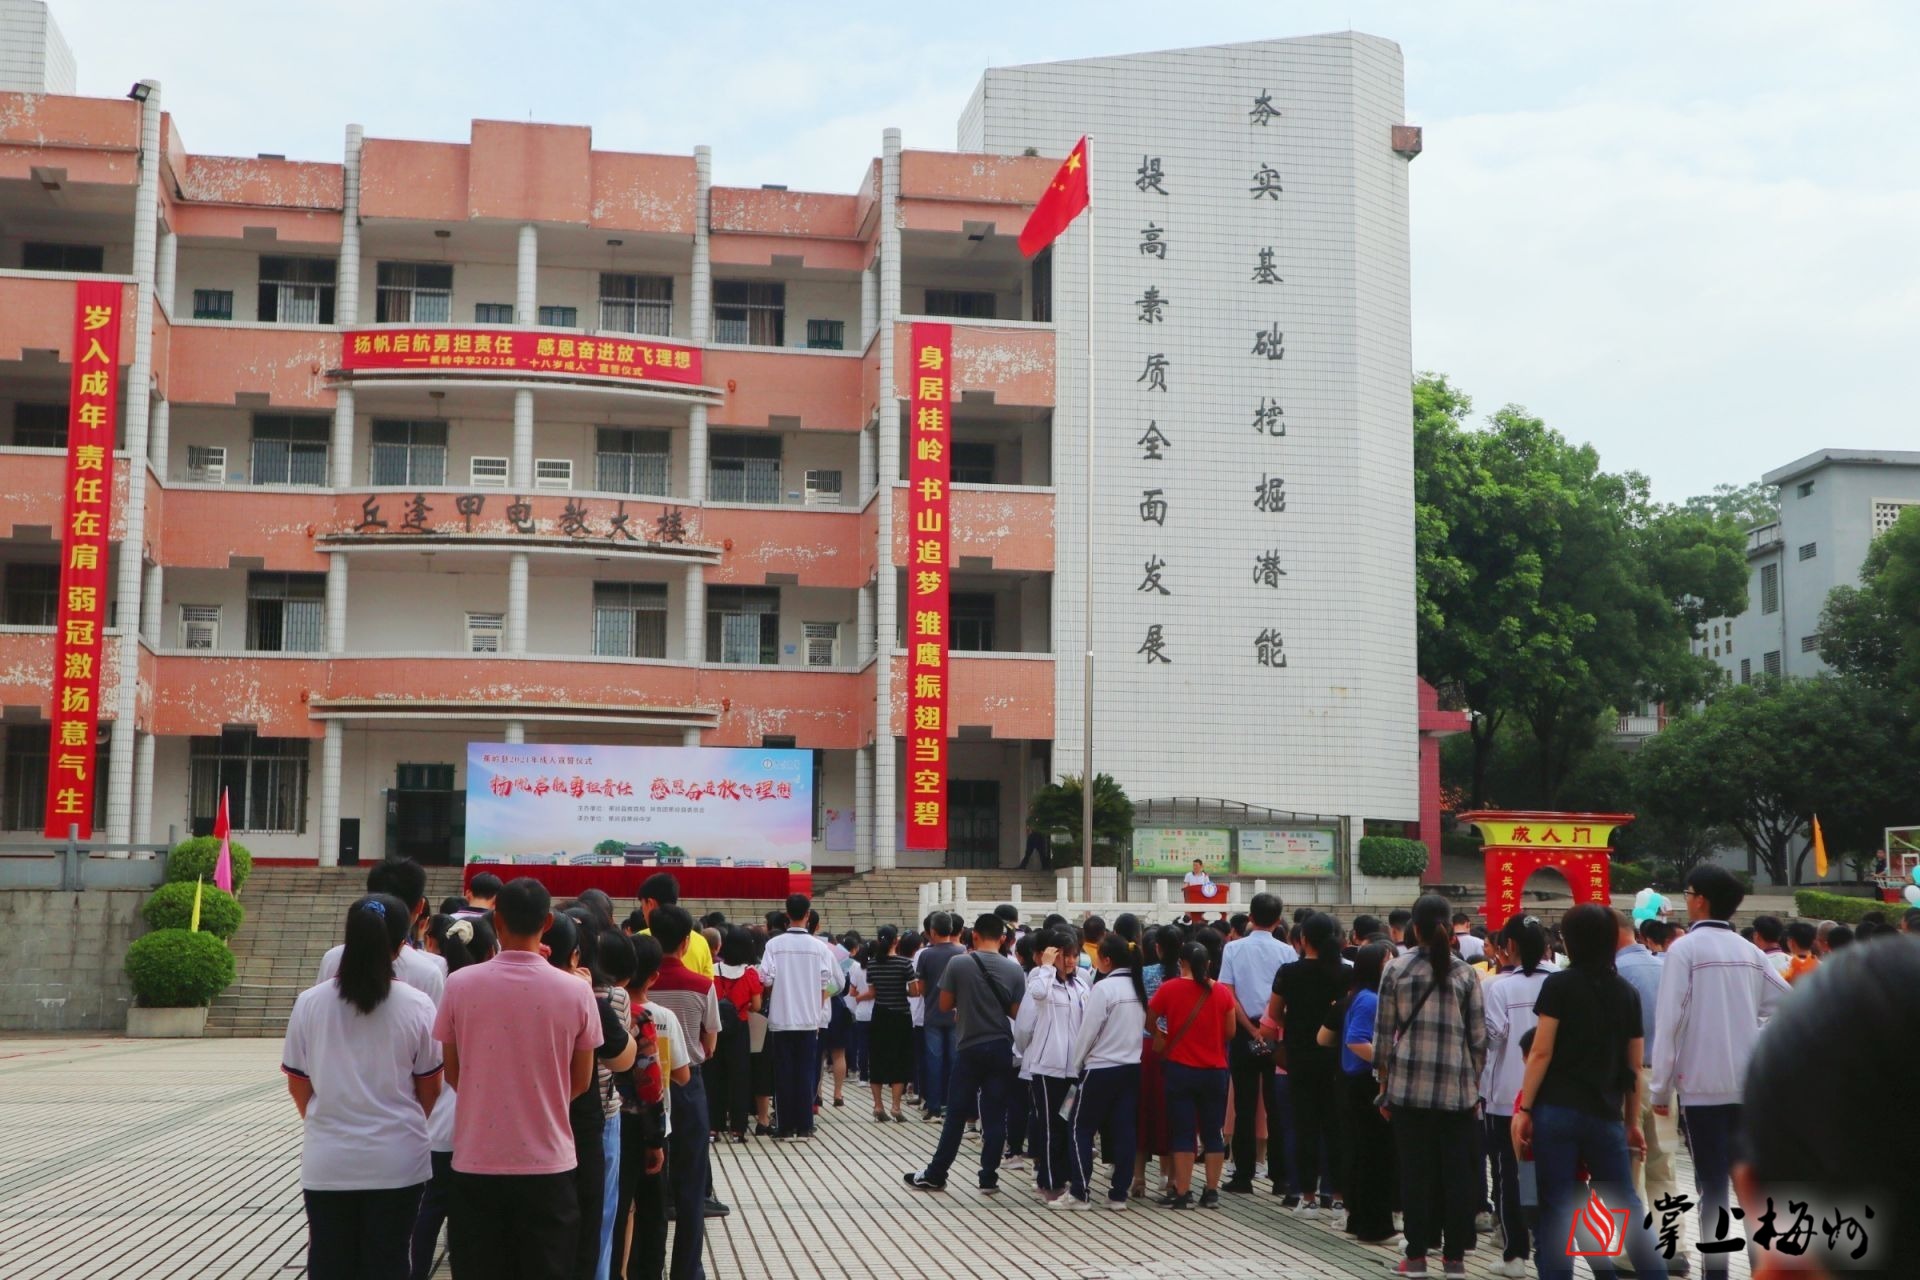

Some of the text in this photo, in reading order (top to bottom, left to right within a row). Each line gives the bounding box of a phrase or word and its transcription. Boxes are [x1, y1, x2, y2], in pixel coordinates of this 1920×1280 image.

[354, 333, 692, 369] 扬帆启航勇担责任 感恩奋进放飞理想
[1248, 88, 1287, 669] 夯实基础挖掘潜能
[1135, 155, 1171, 665] 提高素质全面发展
[354, 491, 688, 545] 丘逢甲电教大楼
[1511, 825, 1592, 844] 成人门
